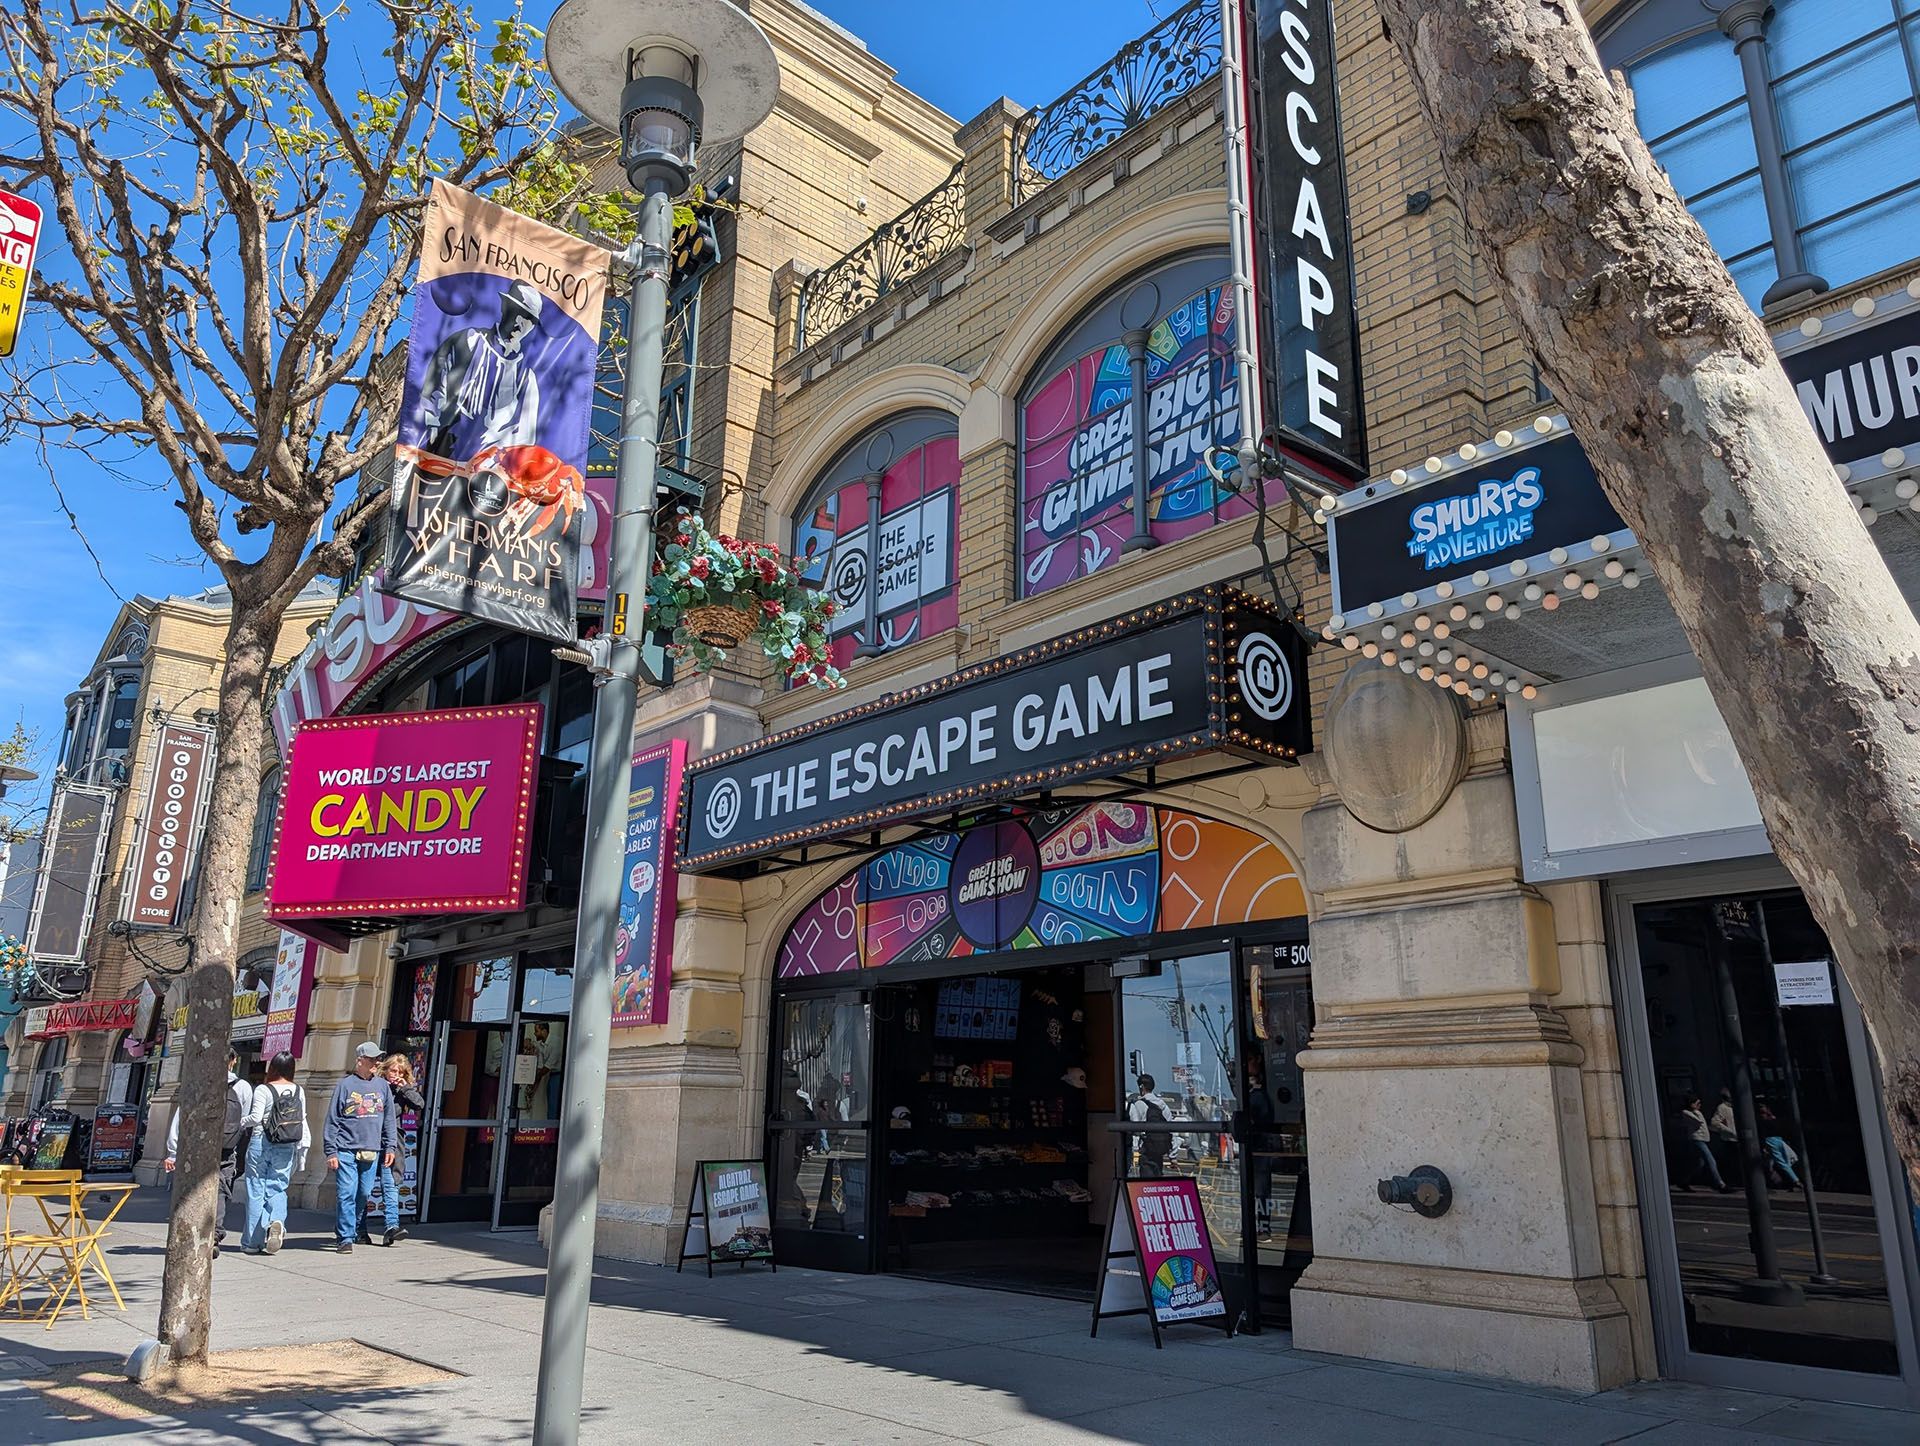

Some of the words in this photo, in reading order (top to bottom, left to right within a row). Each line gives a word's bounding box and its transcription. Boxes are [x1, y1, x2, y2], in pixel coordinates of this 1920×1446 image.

[1279, 0, 1342, 439] SCAPE
[440, 227, 482, 263] SAN
[486, 243, 589, 311] FRANCISCO
[1070, 402, 1133, 469] GREA
[1149, 355, 1210, 432] BIG
[1043, 449, 1134, 533] GAME
[407, 473, 562, 567] FISHERMAN'S
[1413, 471, 1540, 543] SMURFS
[879, 534, 935, 573] ESCAPE
[880, 525, 906, 552] THE
[1407, 541, 1426, 556] THE
[1428, 514, 1532, 568] ADVENTURE
[405, 530, 563, 590] WHARF
[420, 563, 546, 609] fishermanswharf.org
[878, 565, 918, 597] GAME
[167, 739, 202, 750] FRANCISCO
[751, 759, 819, 820] THE
[829, 706, 997, 801] ESCAPE
[1013, 653, 1173, 752] GAME
[319, 766, 402, 787] WORLD'S
[405, 760, 491, 782] LARGEST
[152, 752, 190, 899] CHOCOLATE
[310, 786, 487, 837] CANDY
[630, 818, 658, 836] CANDY
[306, 841, 422, 861] DEPARTMENT
[424, 837, 483, 856] STORE
[140, 907, 170, 918] STORE
[1274, 947, 1288, 958] STE
[269, 1010, 296, 1025] EXPERIENCE
[719, 1169, 752, 1190] ALCATRAZ
[714, 1188, 740, 1208] ESCAPE
[740, 1183, 760, 1201] GAME
[1137, 1196, 1166, 1224] SPIN
[1166, 1195, 1186, 1222] FOR
[1187, 1195, 1195, 1220] A
[1143, 1224, 1172, 1253] FREE
[1170, 1222, 1202, 1250] GAME
[1171, 1294, 1188, 1308] GAME
[1187, 1290, 1205, 1306] SHOW
[1187, 1283, 1197, 1293] BIG
